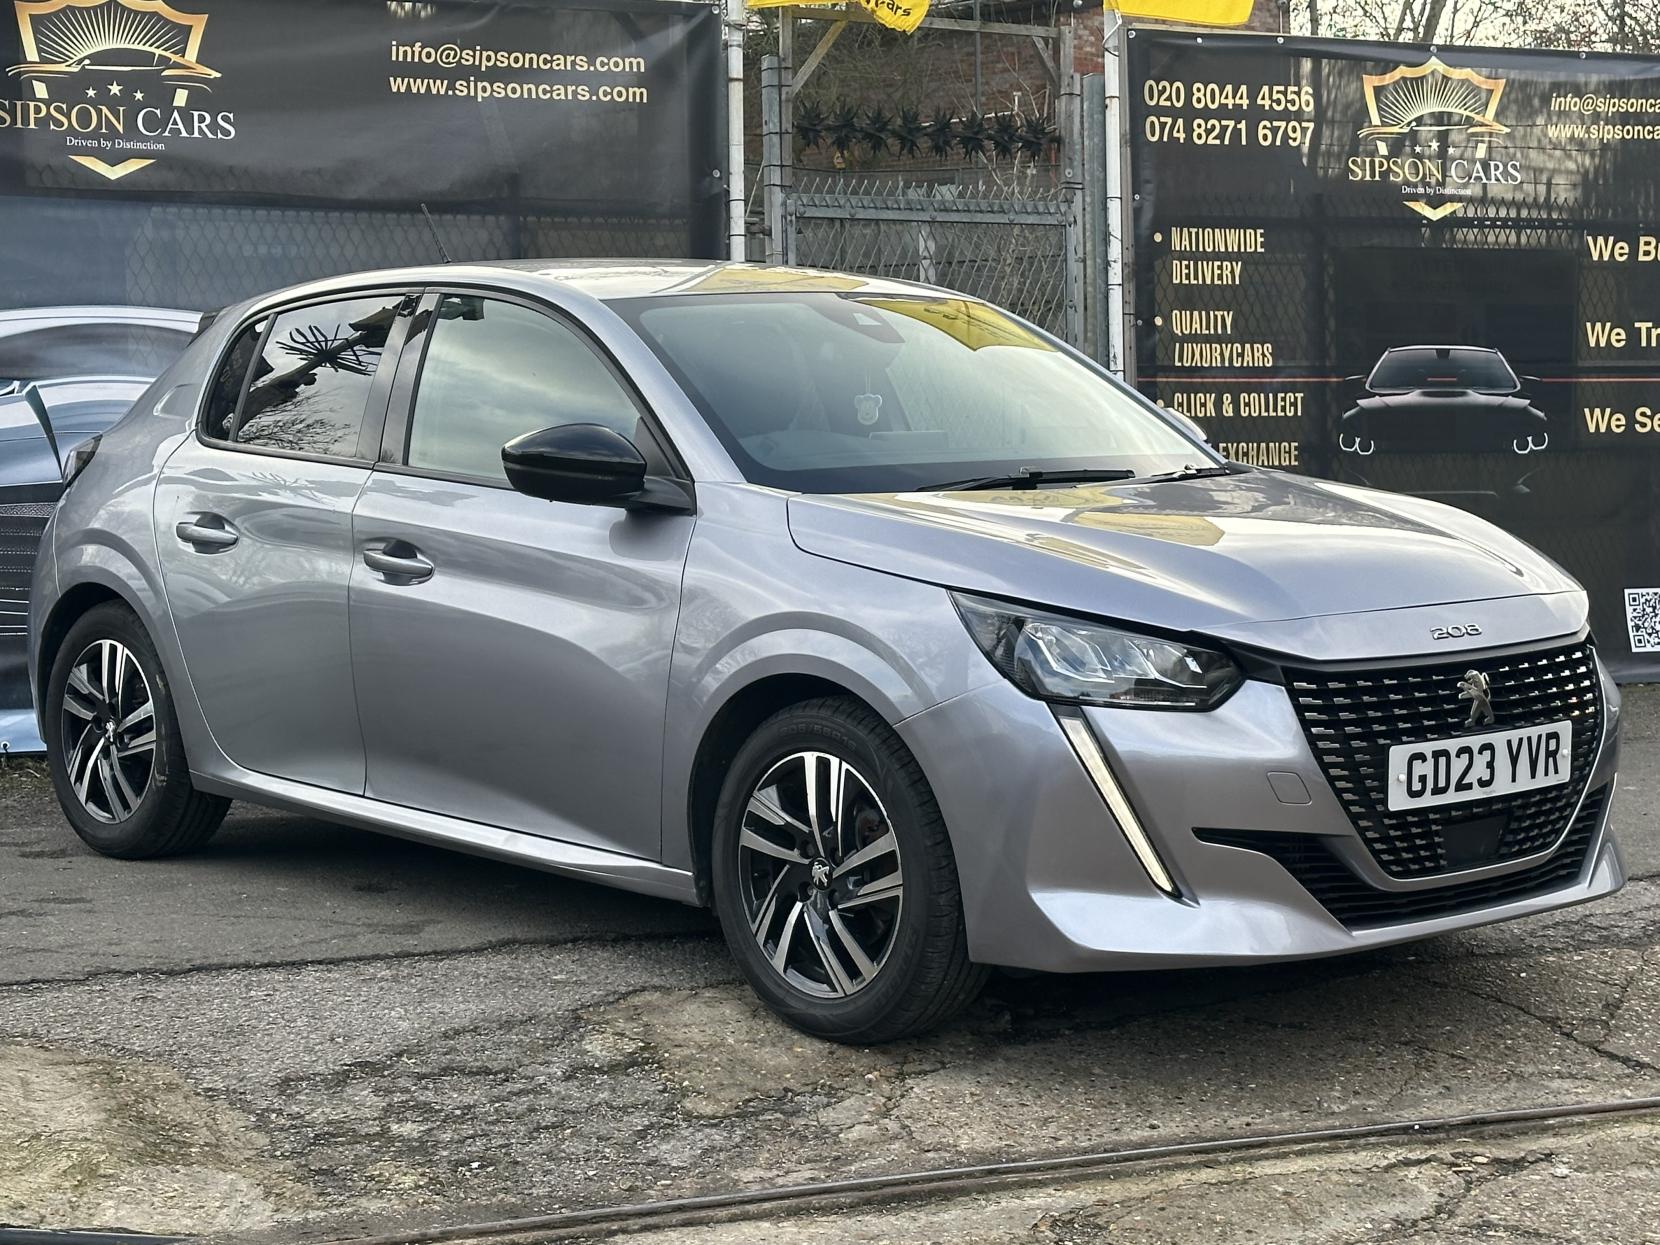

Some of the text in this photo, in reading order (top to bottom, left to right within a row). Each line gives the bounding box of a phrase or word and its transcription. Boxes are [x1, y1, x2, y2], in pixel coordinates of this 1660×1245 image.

[391, 41, 645, 72] info@sipsoncars.com
[389, 76, 648, 103] www.sipsoncars.com
[1144, 79, 1315, 112] 020 8044 4556
[0, 99, 236, 140] SIPSON CARS
[1145, 115, 1315, 147] 074 8271 6797
[1547, 120, 1660, 143] www.sipsonca
[66, 136, 165, 151] Driven by Distinction
[1348, 156, 1521, 185] SIPSON CARS
[1401, 185, 1472, 196] Driven by Distinction
[1171, 226, 1265, 253] NATIONWIDE
[1587, 235, 1660, 262] We B
[1172, 260, 1242, 285] DELIVERY
[1171, 309, 1233, 337] QUALITY
[1585, 321, 1660, 348] We Tr
[1174, 342, 1273, 368] LUXURYCARS
[1174, 392, 1304, 417] CLICK & COLLECT
[1583, 407, 1626, 433] We
[1430, 622, 1482, 640] 208
[1406, 731, 1560, 799] GD23 YVR
